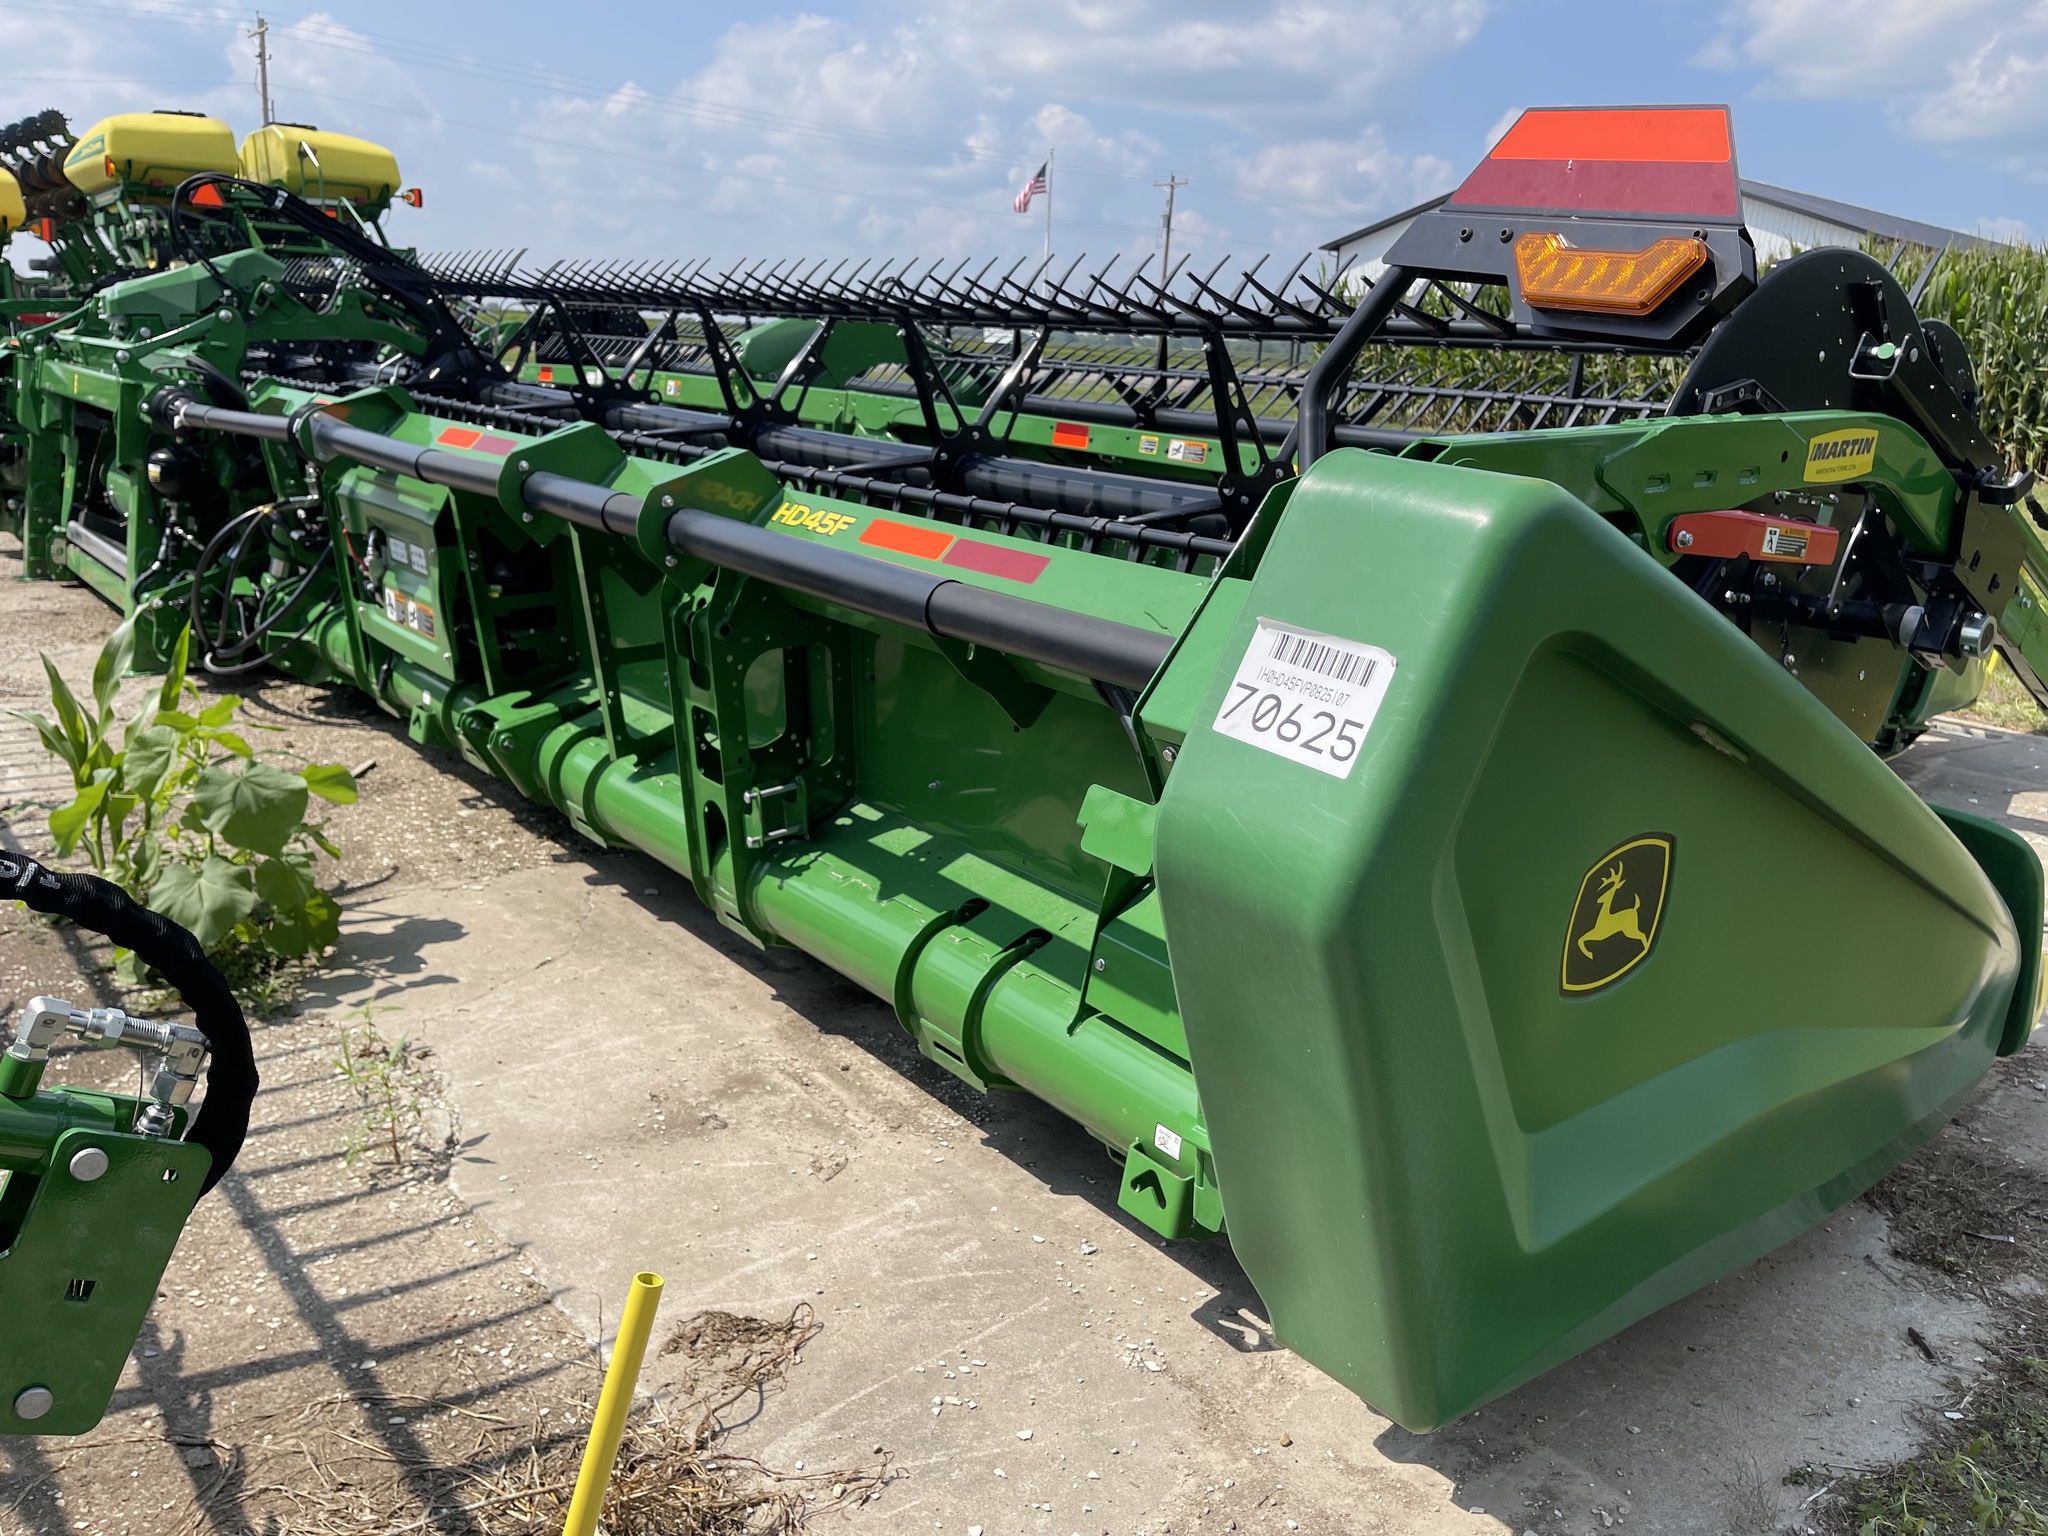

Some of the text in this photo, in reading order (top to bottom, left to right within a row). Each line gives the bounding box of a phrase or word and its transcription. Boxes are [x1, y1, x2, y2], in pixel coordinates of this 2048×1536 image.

[1809, 436, 1875, 462] MARTIN
[770, 501, 857, 537] HD45F
[1256, 666, 1350, 708] 1H0HD45FVP0825107
[1221, 681, 1365, 762] 70625
